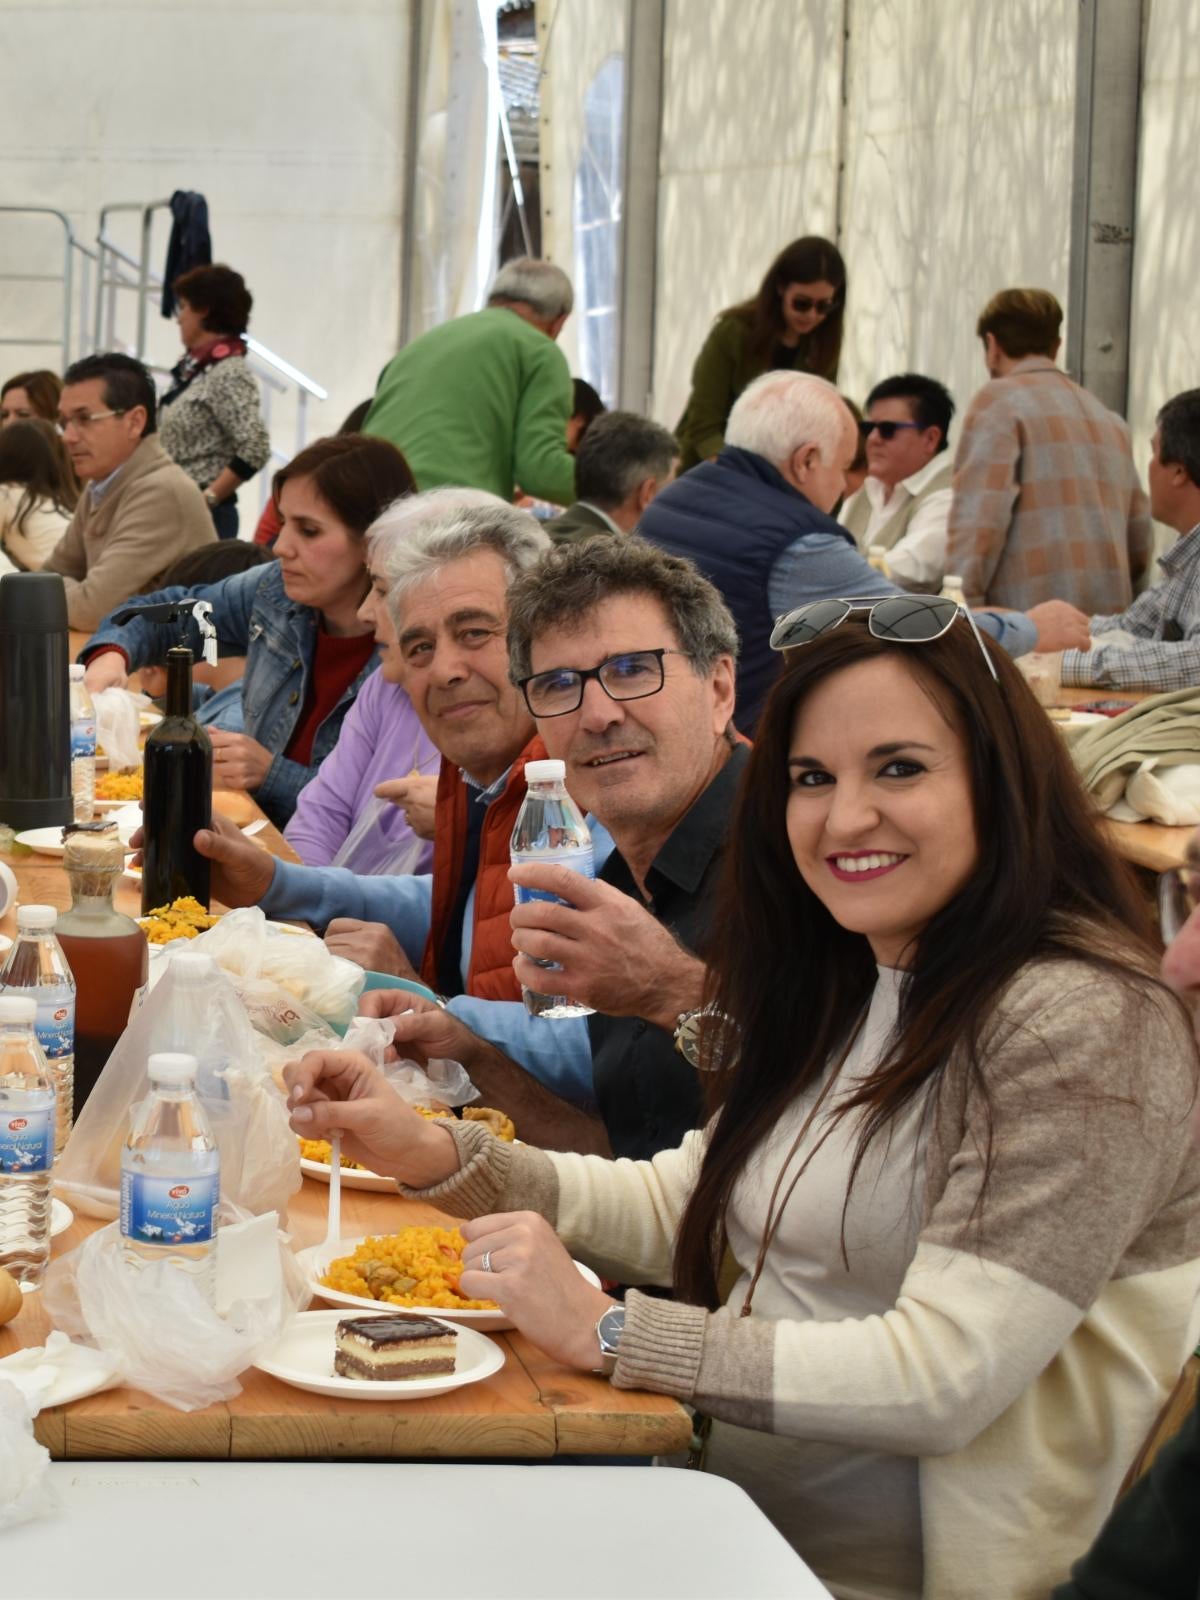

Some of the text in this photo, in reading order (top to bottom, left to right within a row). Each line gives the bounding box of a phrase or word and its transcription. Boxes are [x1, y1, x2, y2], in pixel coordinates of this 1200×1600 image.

[17, 1141, 43, 1150] Natural
[121, 1172, 134, 1235] Fuentevera
[167, 1201, 190, 1210] Agua
[147, 1209, 206, 1220] Mineral Natural
